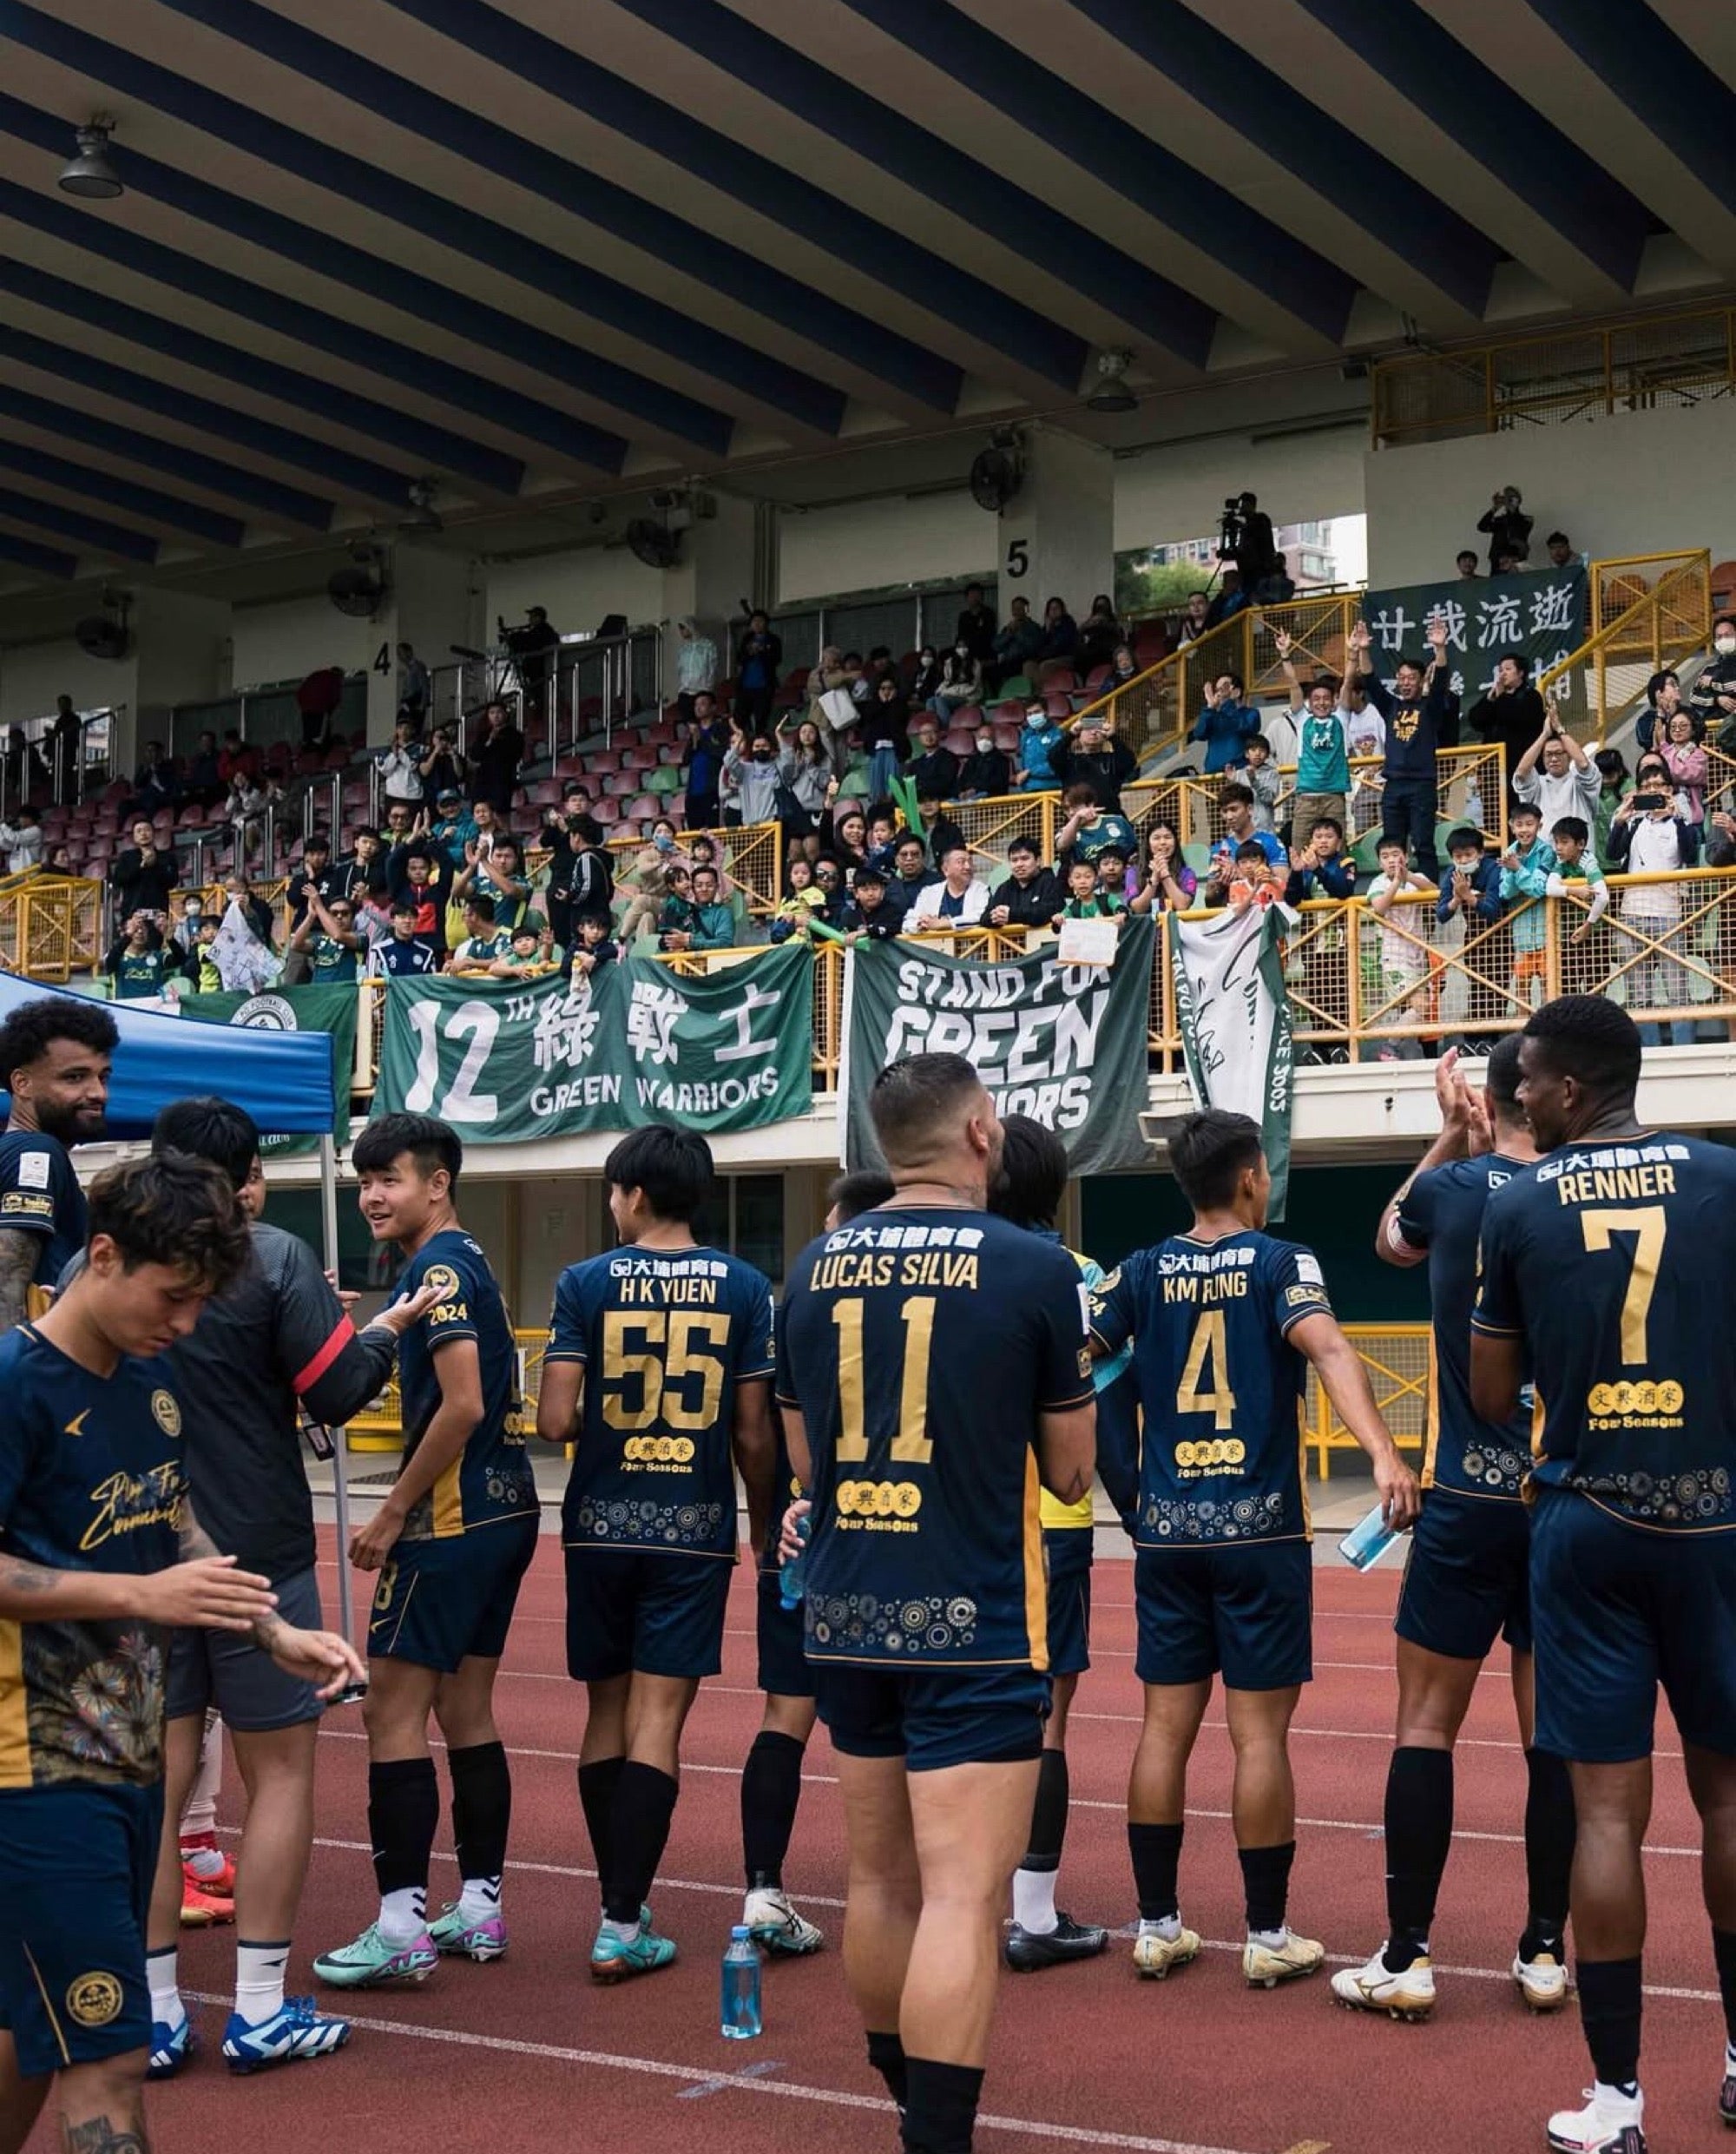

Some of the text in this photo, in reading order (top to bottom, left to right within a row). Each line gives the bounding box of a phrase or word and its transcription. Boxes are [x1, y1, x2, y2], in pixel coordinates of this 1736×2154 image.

[1007, 539, 1028, 578] 5
[373, 642, 391, 676] 4
[897, 959, 1025, 1008] STAND
[884, 989, 1110, 1085] GREEN
[529, 1066, 779, 1116] GREEN WARRIORS
[988, 1075, 1092, 1131] IORS
[1556, 1163, 1677, 1206] RENNER
[660, 1278, 717, 1304] YUEN
[810, 1251, 979, 1291] LUCAS SILVA
[1163, 1275, 1198, 1303] KM
[1580, 1205, 1667, 1366] 7
[602, 1310, 732, 1431] 55
[831, 1295, 937, 1464] 11
[1177, 1309, 1237, 1431] 4
